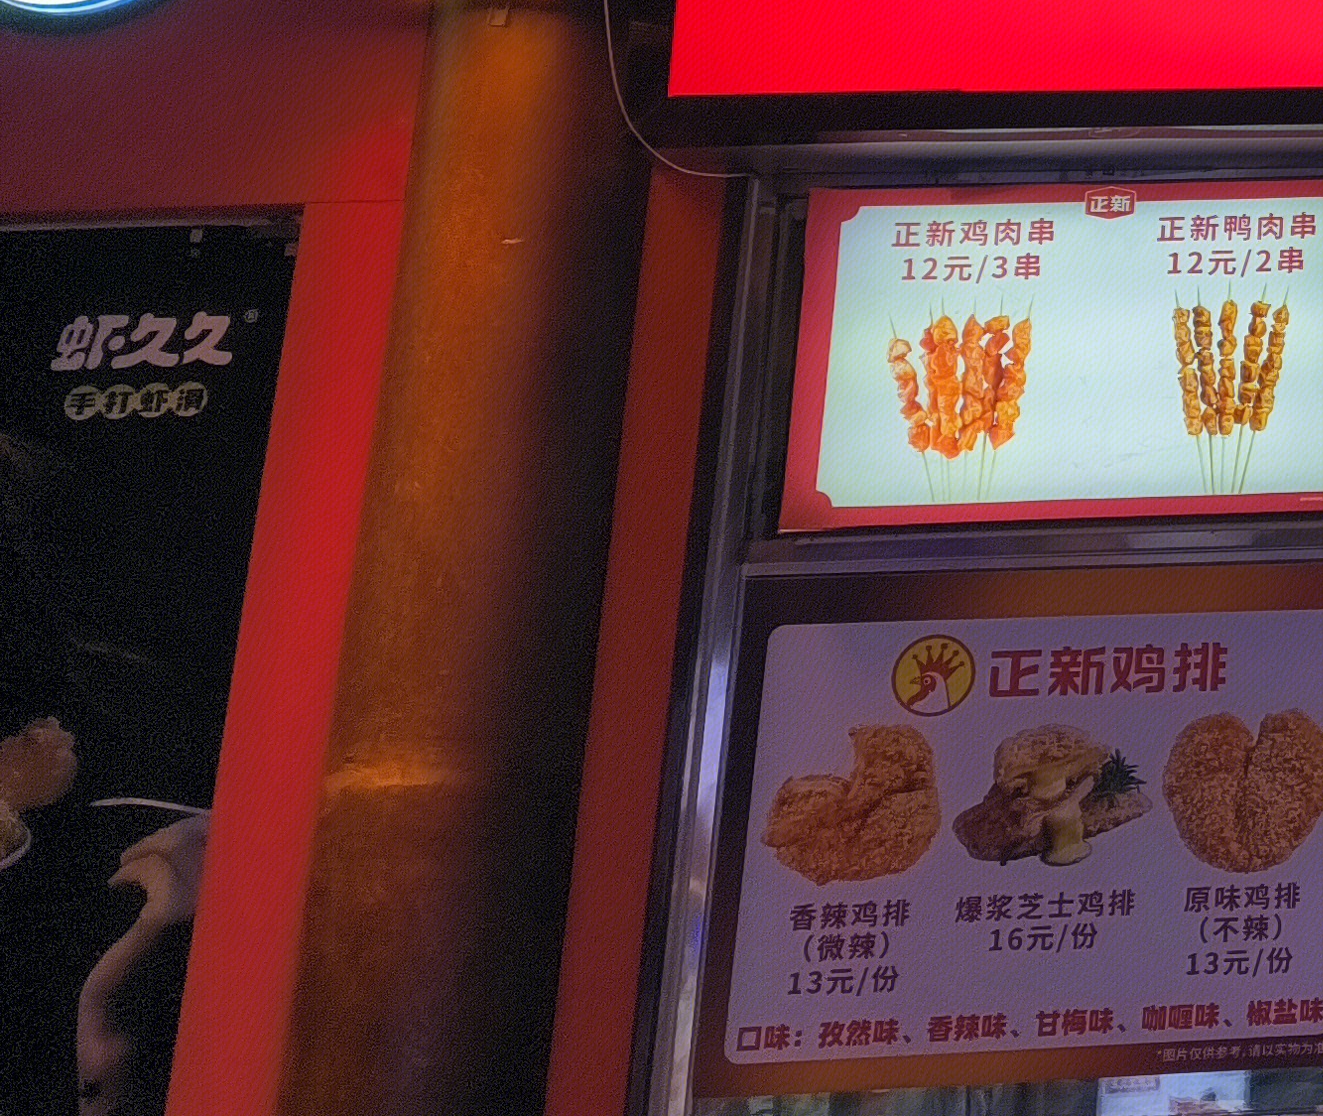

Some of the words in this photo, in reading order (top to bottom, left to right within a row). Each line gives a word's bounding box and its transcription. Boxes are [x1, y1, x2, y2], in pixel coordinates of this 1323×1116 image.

[1089, 194, 1131, 214] 正新
[891, 217, 1056, 249] 正新鸡肉串
[1157, 211, 1318, 243] 正新鸭肉串
[900, 252, 1043, 283] 12元/3串
[1166, 246, 1306, 278] 12元/2串
[50, 311, 233, 372] 虾久久
[64, 382, 208, 421] 手打虾滑
[988, 642, 1230, 699] 正新鸡排
[954, 888, 1136, 924] 爆浆芝士鸡排
[1183, 881, 1302, 913] 原味鸡排
[789, 897, 911, 931] 香辣鸡排
[988, 921, 1099, 954] 16元/份
[1184, 944, 1293, 979] 13元/份
[787, 962, 900, 998] 13元/份
